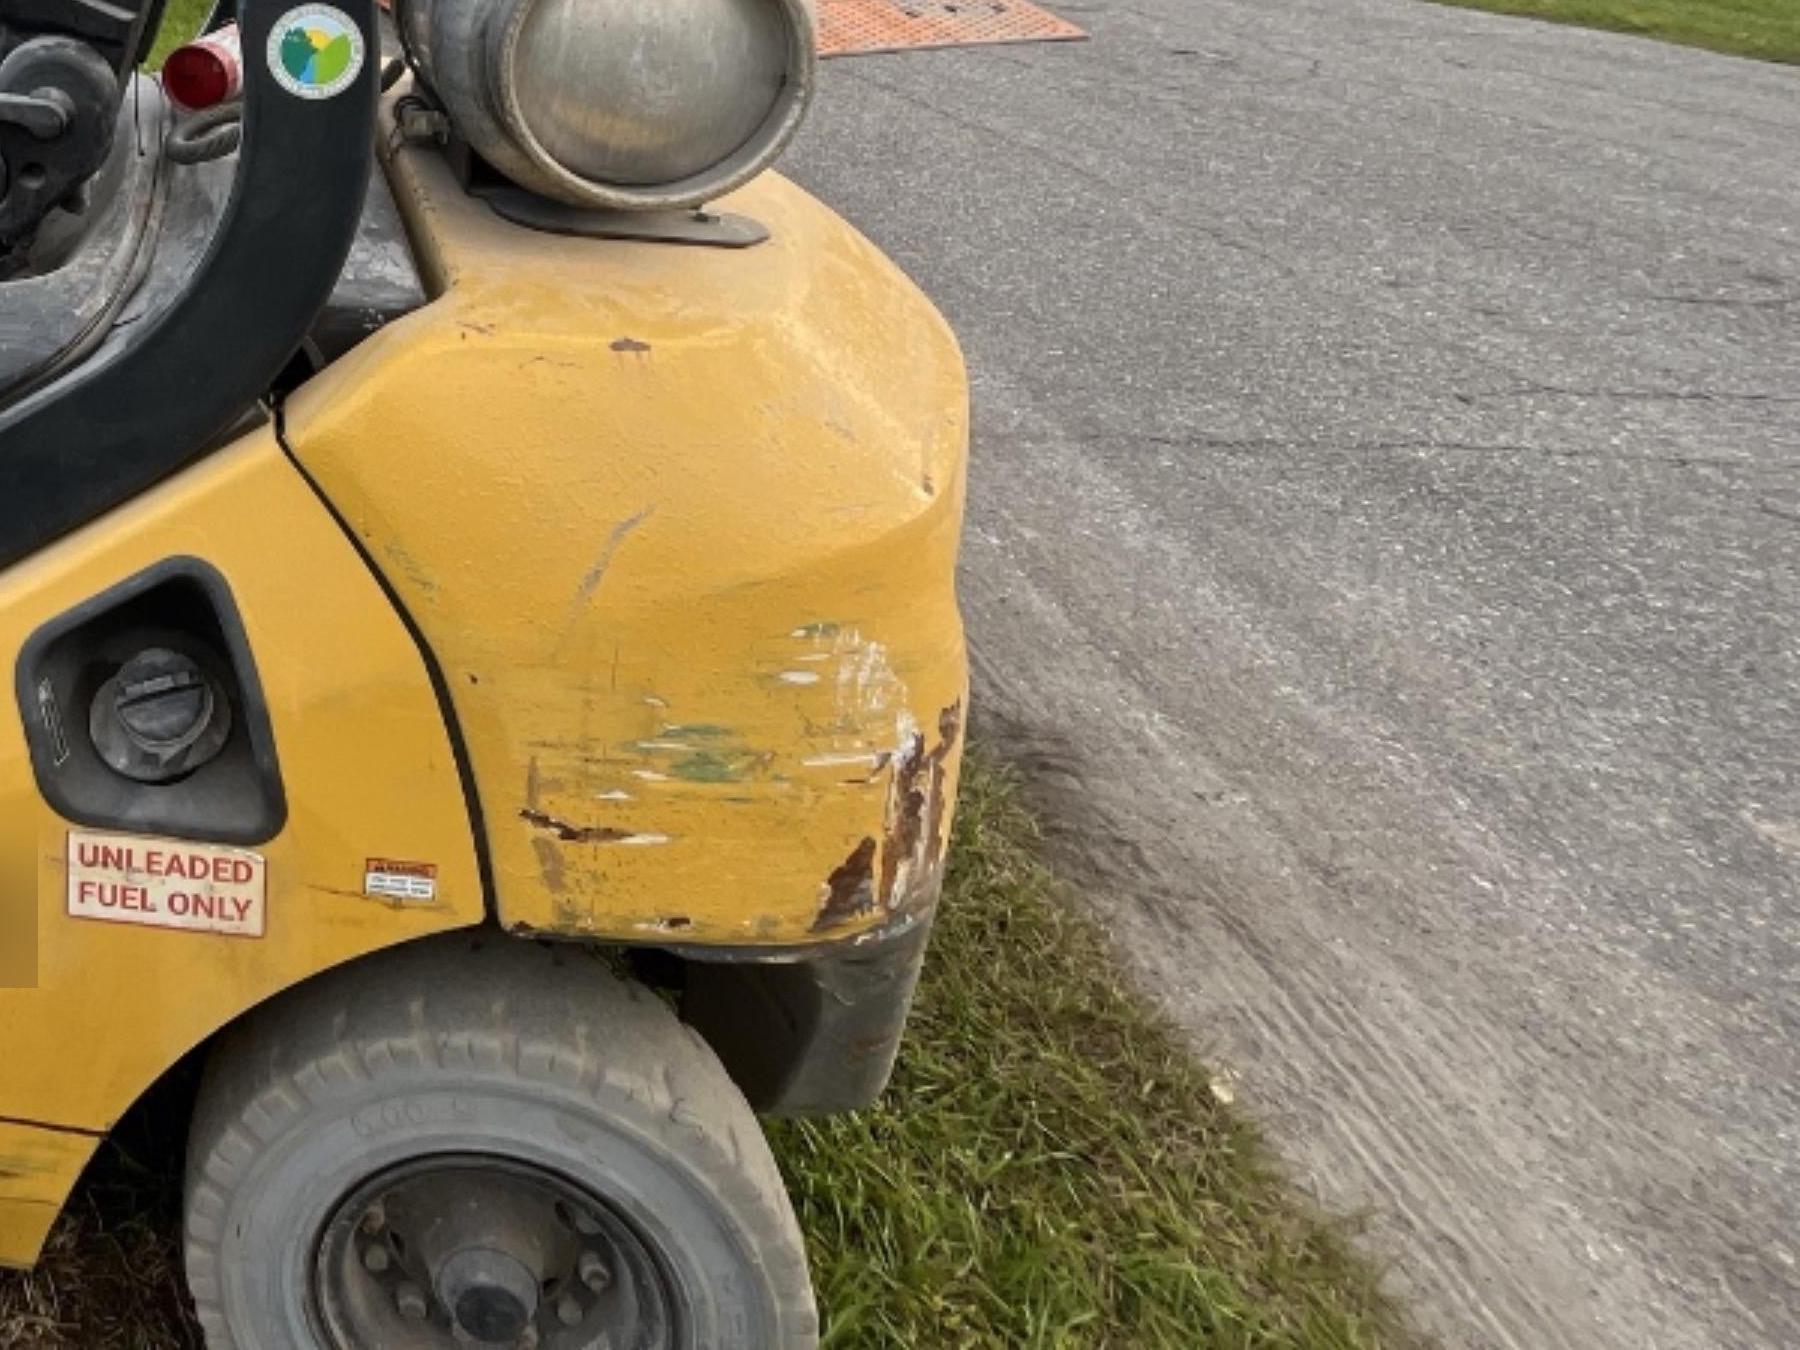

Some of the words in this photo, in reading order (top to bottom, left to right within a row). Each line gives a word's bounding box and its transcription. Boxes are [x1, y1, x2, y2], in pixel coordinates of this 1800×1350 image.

[78, 842, 253, 884] UNLEADED
[78, 881, 157, 913] FUEL
[167, 891, 253, 922] ONLY
